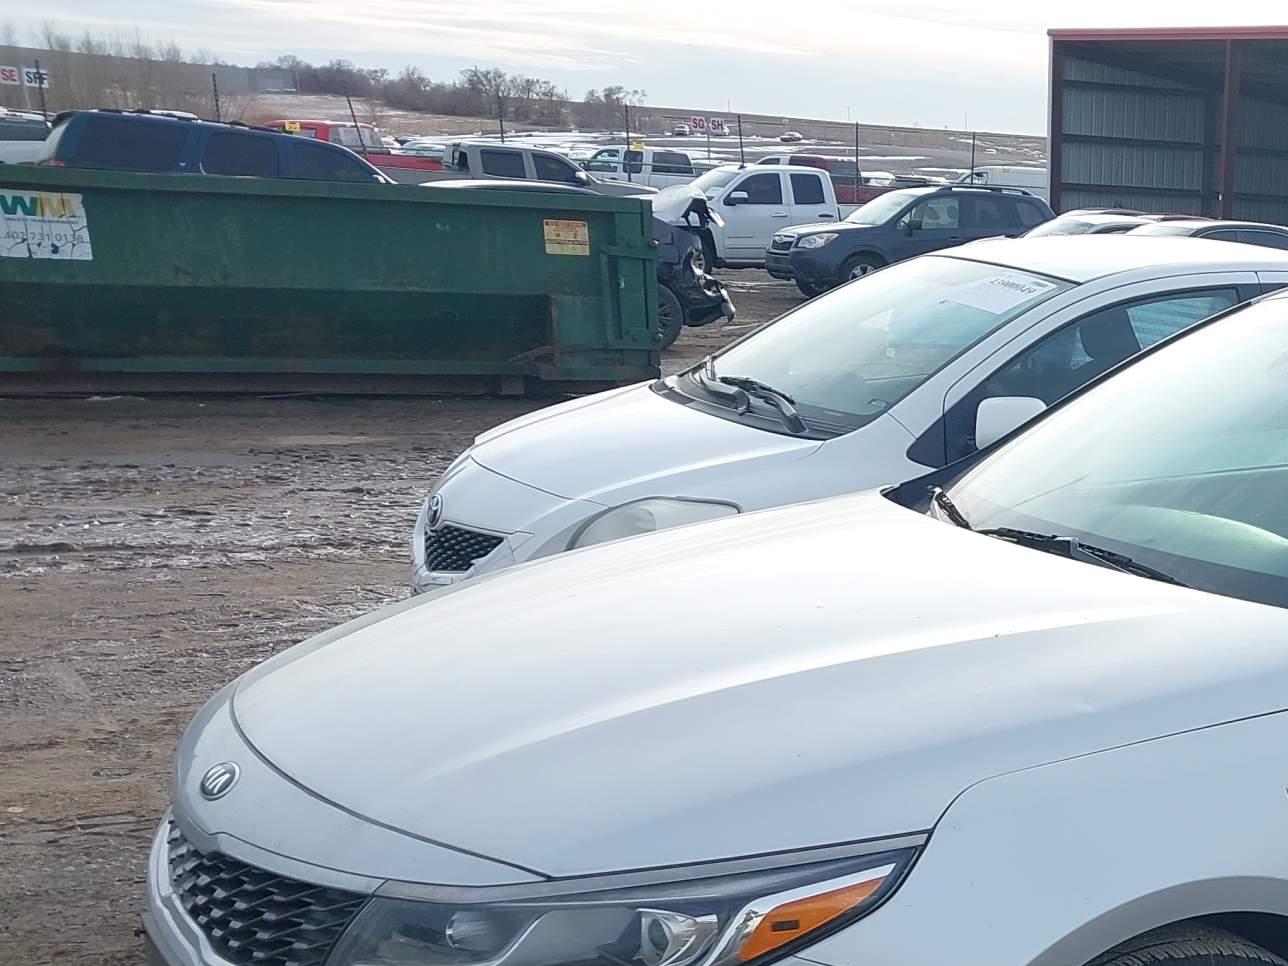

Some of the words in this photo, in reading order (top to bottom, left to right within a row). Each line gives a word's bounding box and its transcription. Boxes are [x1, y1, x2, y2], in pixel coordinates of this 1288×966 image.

[1, 69, 16, 81] SE
[692, 118, 704, 129] SG
[711, 120, 723, 130] SH
[0, 194, 74, 217] WM
